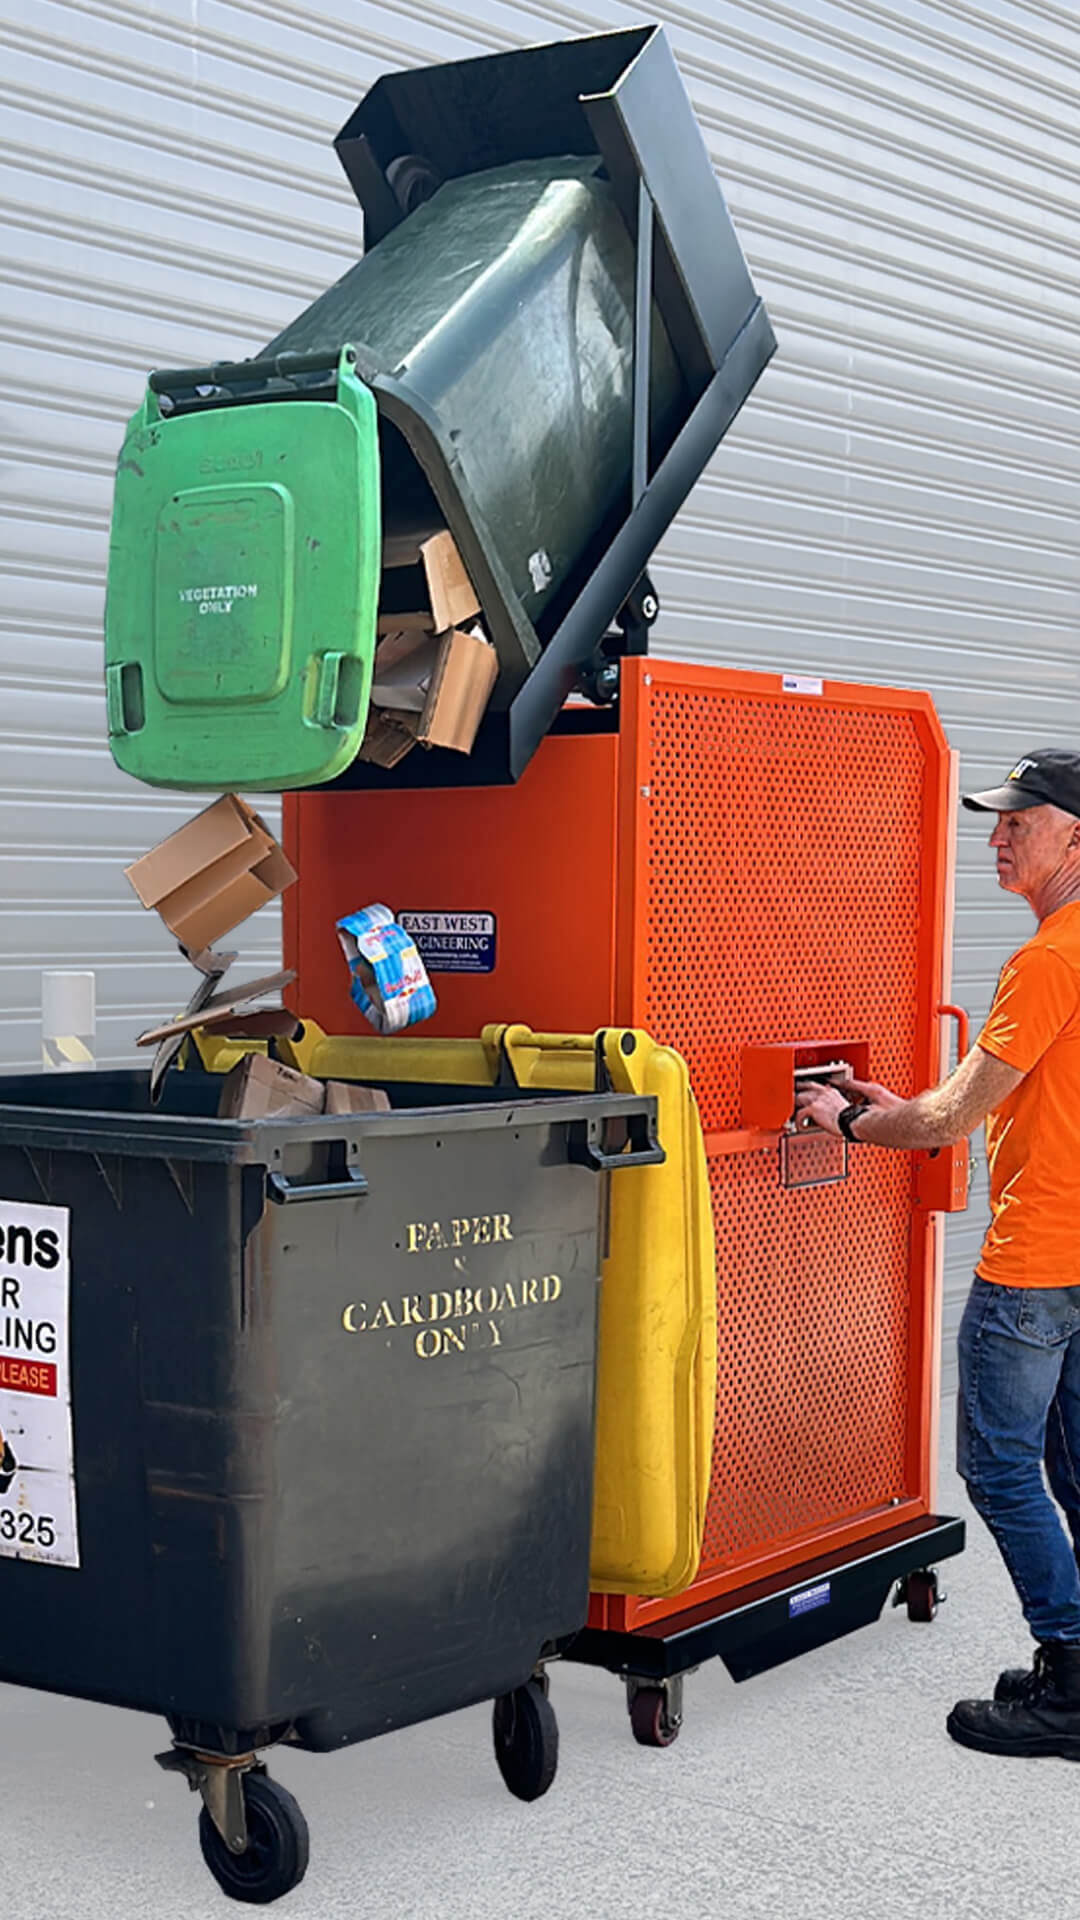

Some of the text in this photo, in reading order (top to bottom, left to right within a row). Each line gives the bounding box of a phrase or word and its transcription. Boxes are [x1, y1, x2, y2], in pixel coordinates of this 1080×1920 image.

[178, 584, 258, 602] VEGETATION
[199, 599, 234, 615] ONLY
[402, 916, 489, 932] EAST WEST
[414, 936, 489, 951] GINEERING
[0, 1225, 60, 1270] ns
[406, 1213, 514, 1253] PAPER
[341, 1274, 562, 1333] CARDBOARD
[0, 1316, 56, 1354] ING
[0, 1361, 50, 1390] LEASE
